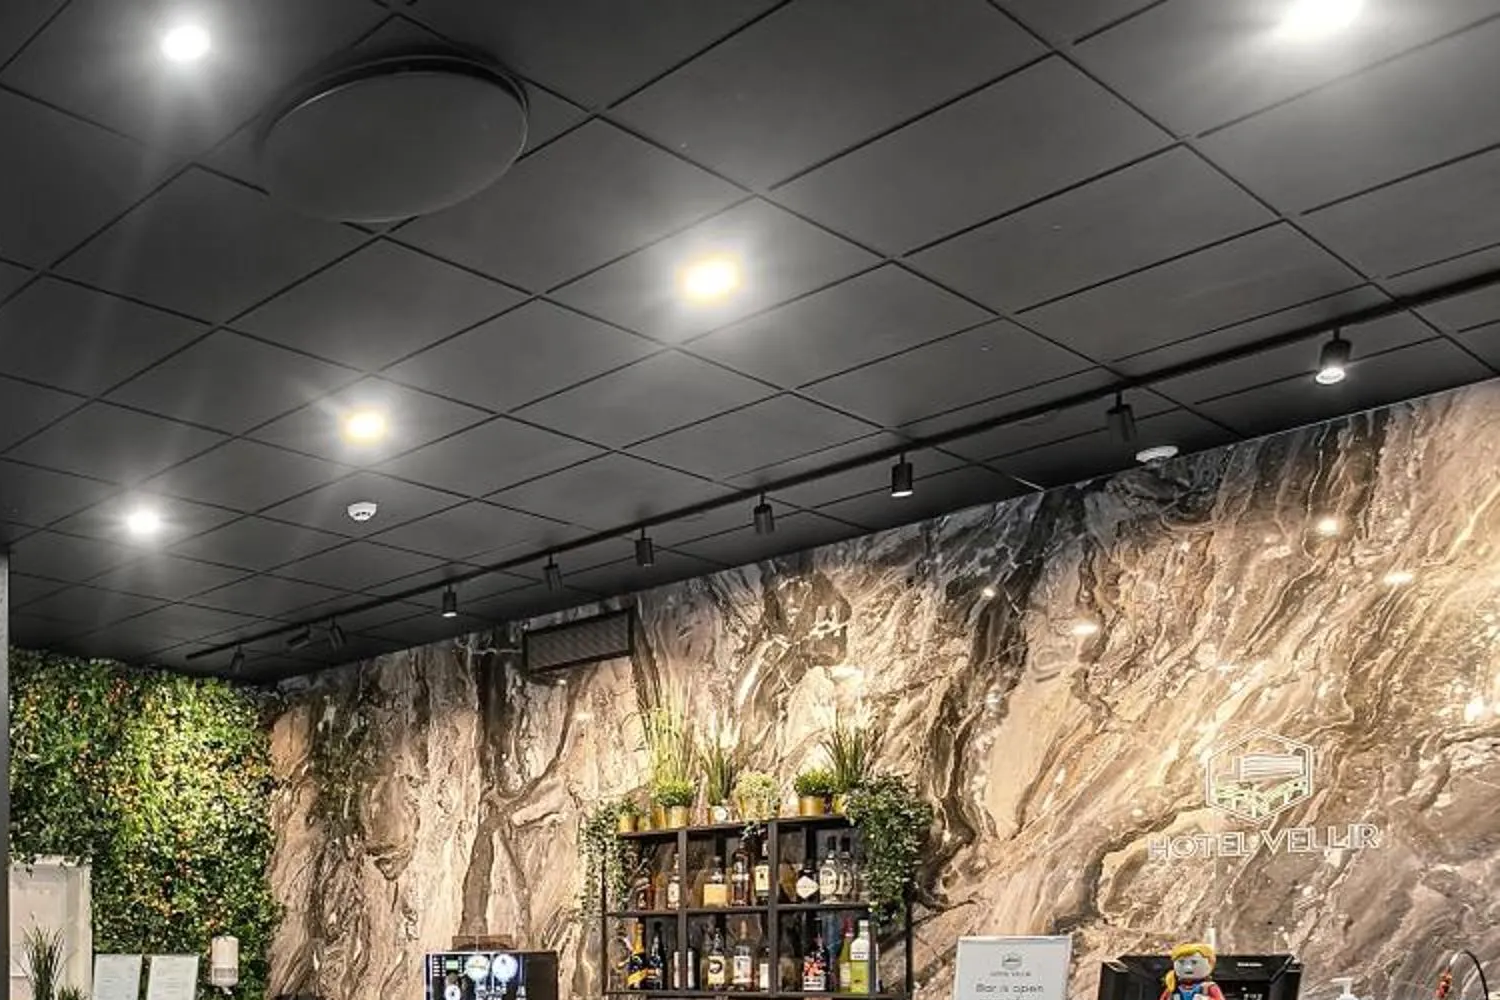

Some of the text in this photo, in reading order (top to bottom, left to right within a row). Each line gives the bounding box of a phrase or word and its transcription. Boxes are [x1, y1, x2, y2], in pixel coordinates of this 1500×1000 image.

[1148, 823, 1380, 860] HOTEL VELLIR
[975, 983, 997, 993] Bar
[1012, 985, 1044, 995] open
